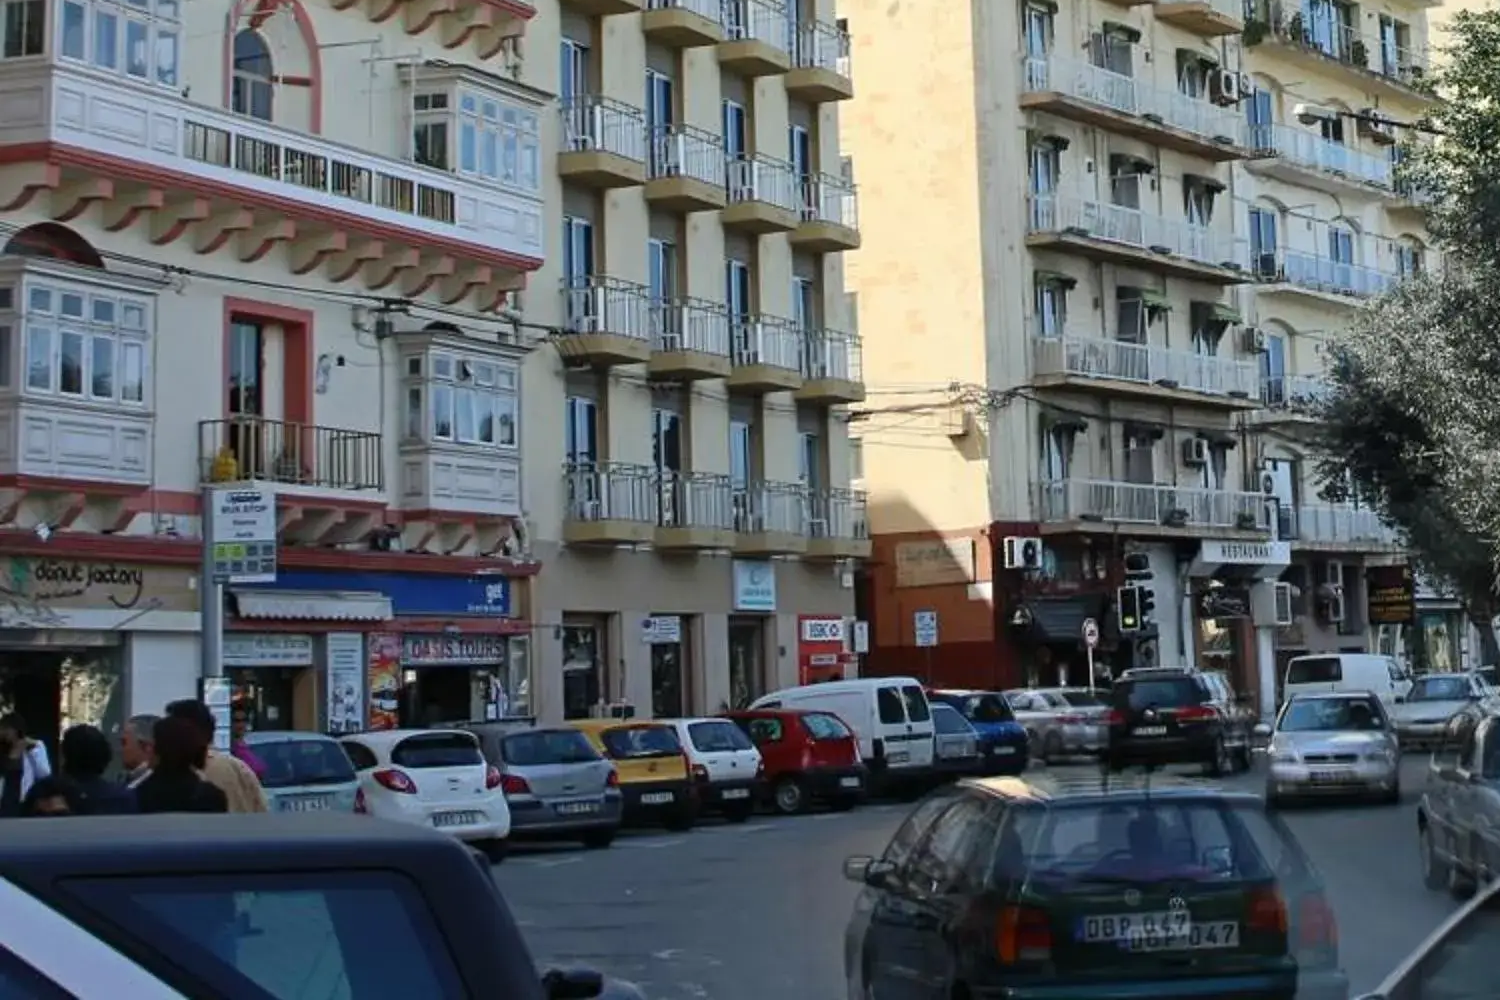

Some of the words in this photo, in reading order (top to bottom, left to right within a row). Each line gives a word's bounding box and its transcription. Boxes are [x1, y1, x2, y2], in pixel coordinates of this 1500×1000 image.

[1221, 543, 1273, 560] RESTAURANT
[86, 563, 143, 609] factory
[411, 639, 454, 659] OASIS
[460, 638, 504, 659] TOURS
